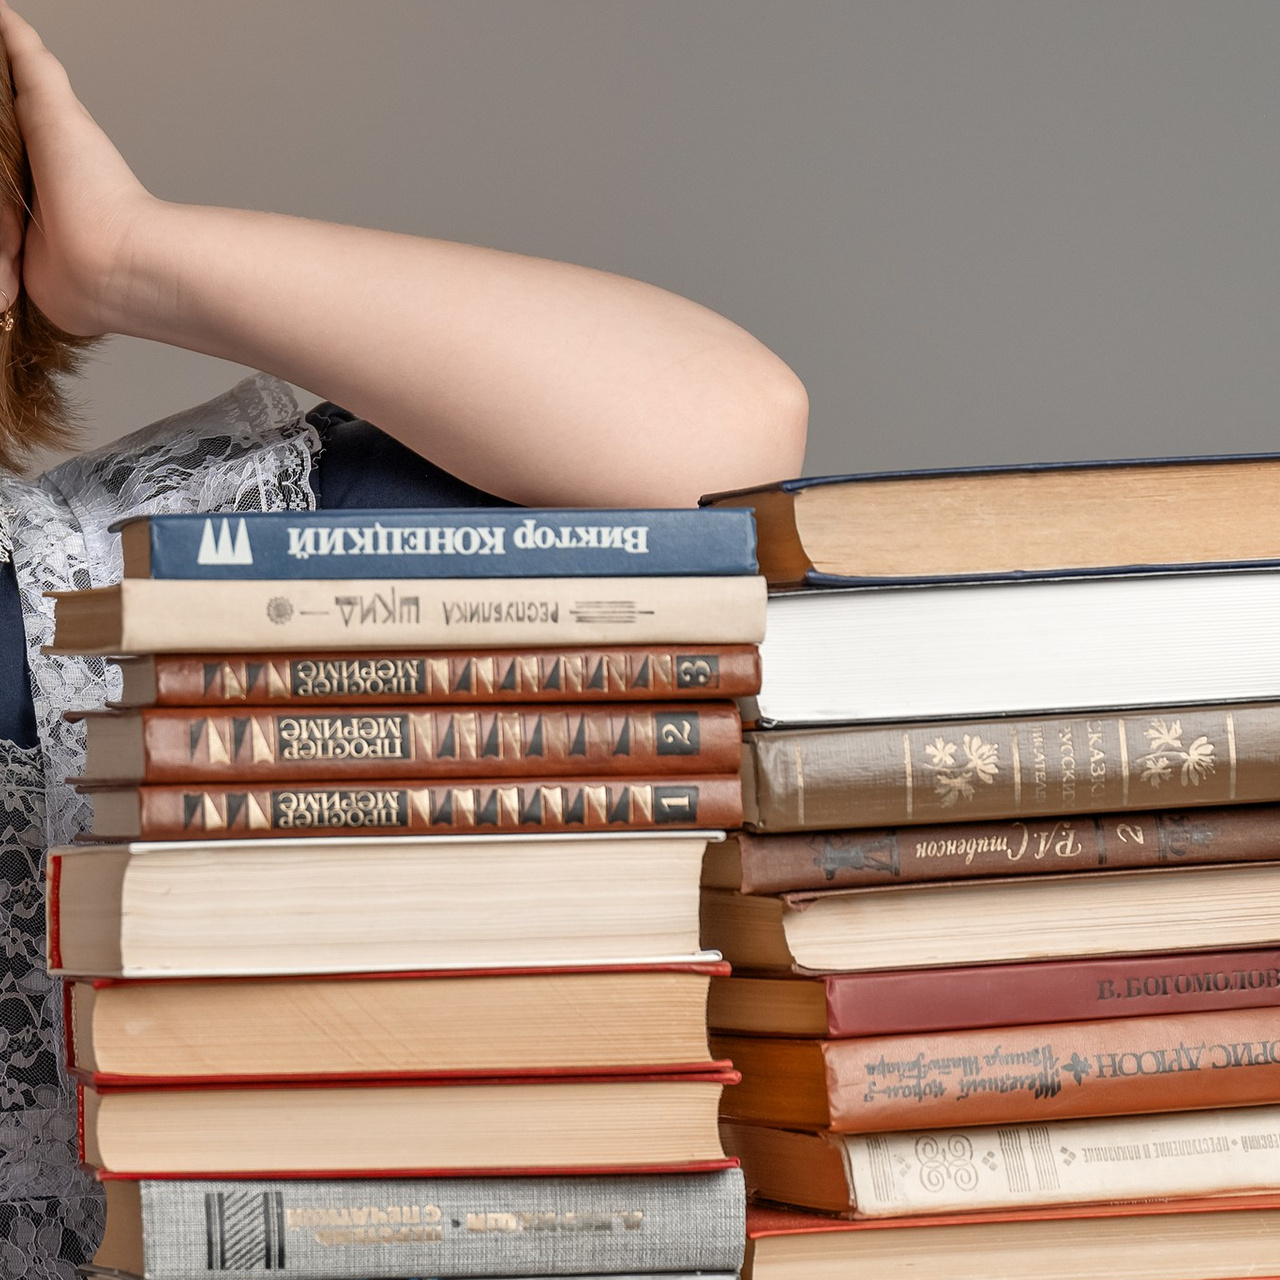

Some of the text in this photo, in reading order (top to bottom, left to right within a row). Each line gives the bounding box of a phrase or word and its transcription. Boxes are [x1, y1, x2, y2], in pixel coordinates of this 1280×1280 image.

[287, 519, 650, 560] Виктор КОНЕЦКИЙ
[333, 586, 560, 628] РЕСПУБЛИКА ШКИД
[298, 676, 420, 696] ПРОСПЕР
[680, 659, 712, 689] 3
[661, 719, 693, 747] 2
[283, 737, 403, 760] ПРОСПЕР
[1086, 719, 1107, 806] СКАЗК
[661, 792, 693, 812] 1
[278, 808, 401, 829] ПРОСПЕР
[1239, 1132, 1280, 1152] ЕВСКИЙ
